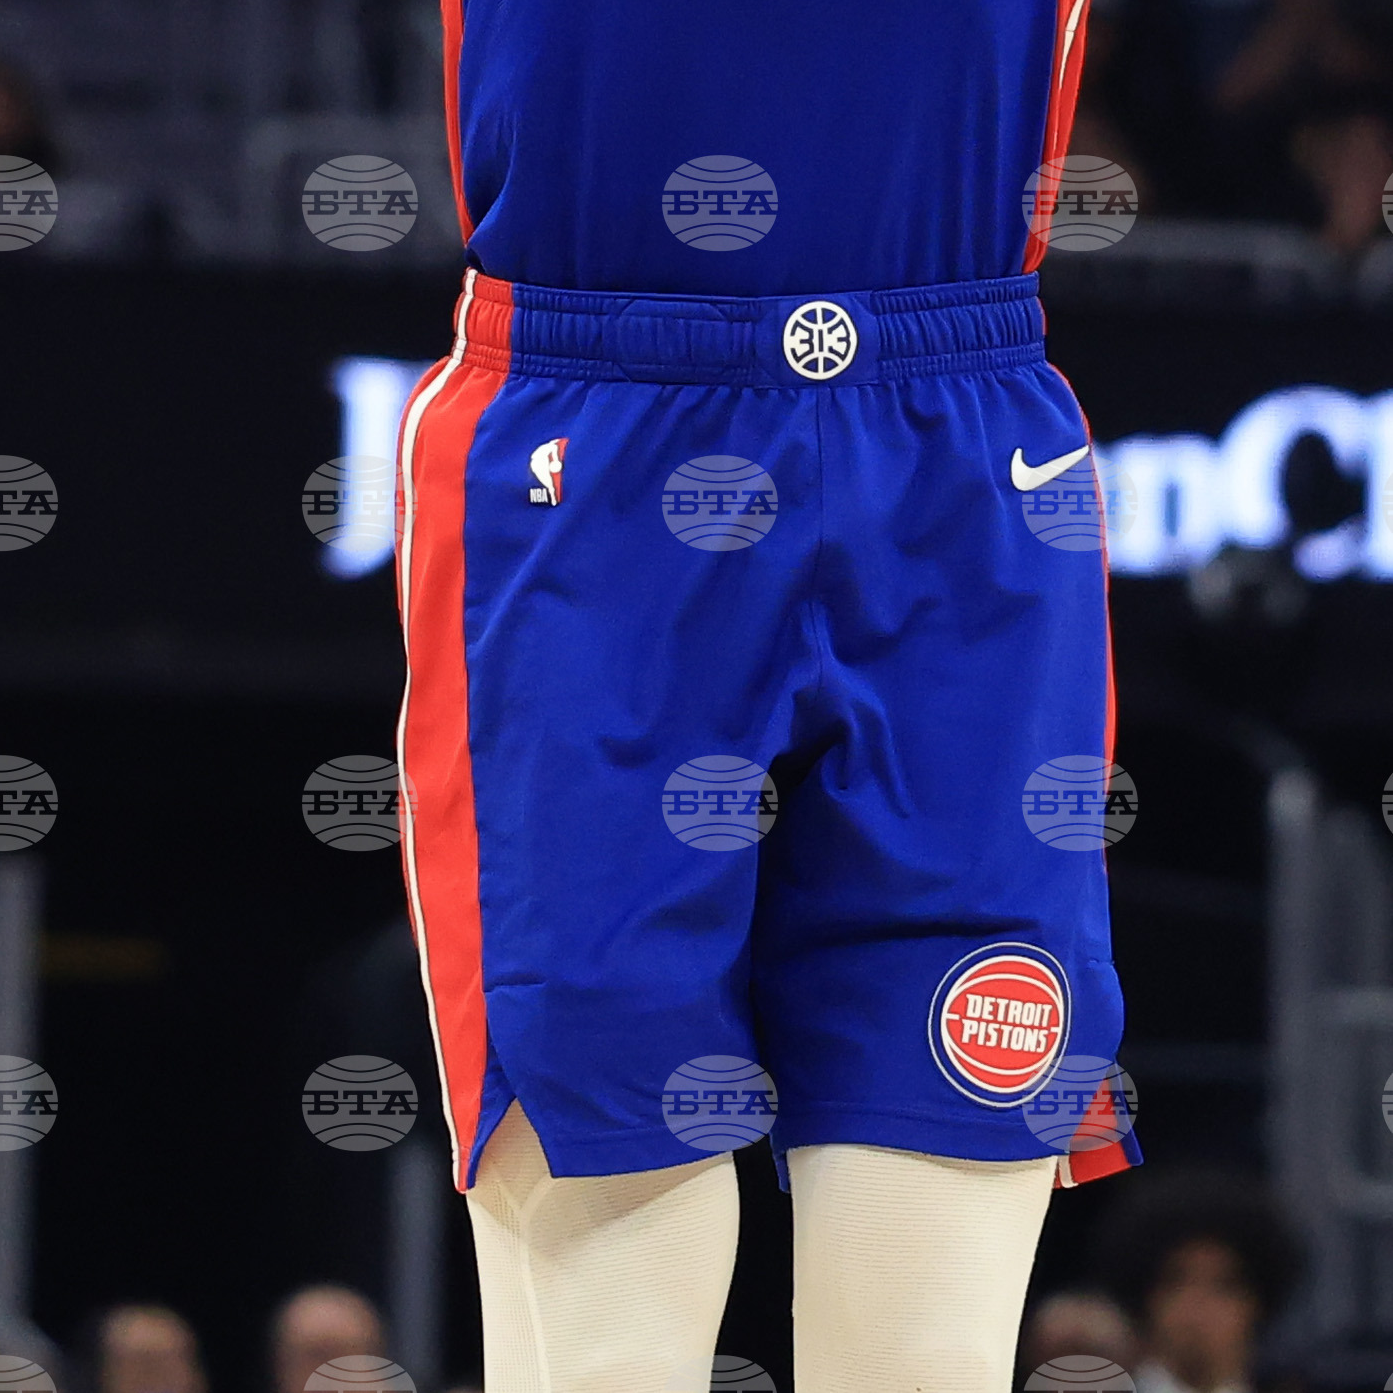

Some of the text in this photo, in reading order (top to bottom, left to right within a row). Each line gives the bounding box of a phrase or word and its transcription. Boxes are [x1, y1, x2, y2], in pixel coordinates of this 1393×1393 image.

[529, 488, 549, 503] NBA
[965, 993, 1053, 1028] DETROIT
[960, 1018, 1049, 1054] PISTONS
